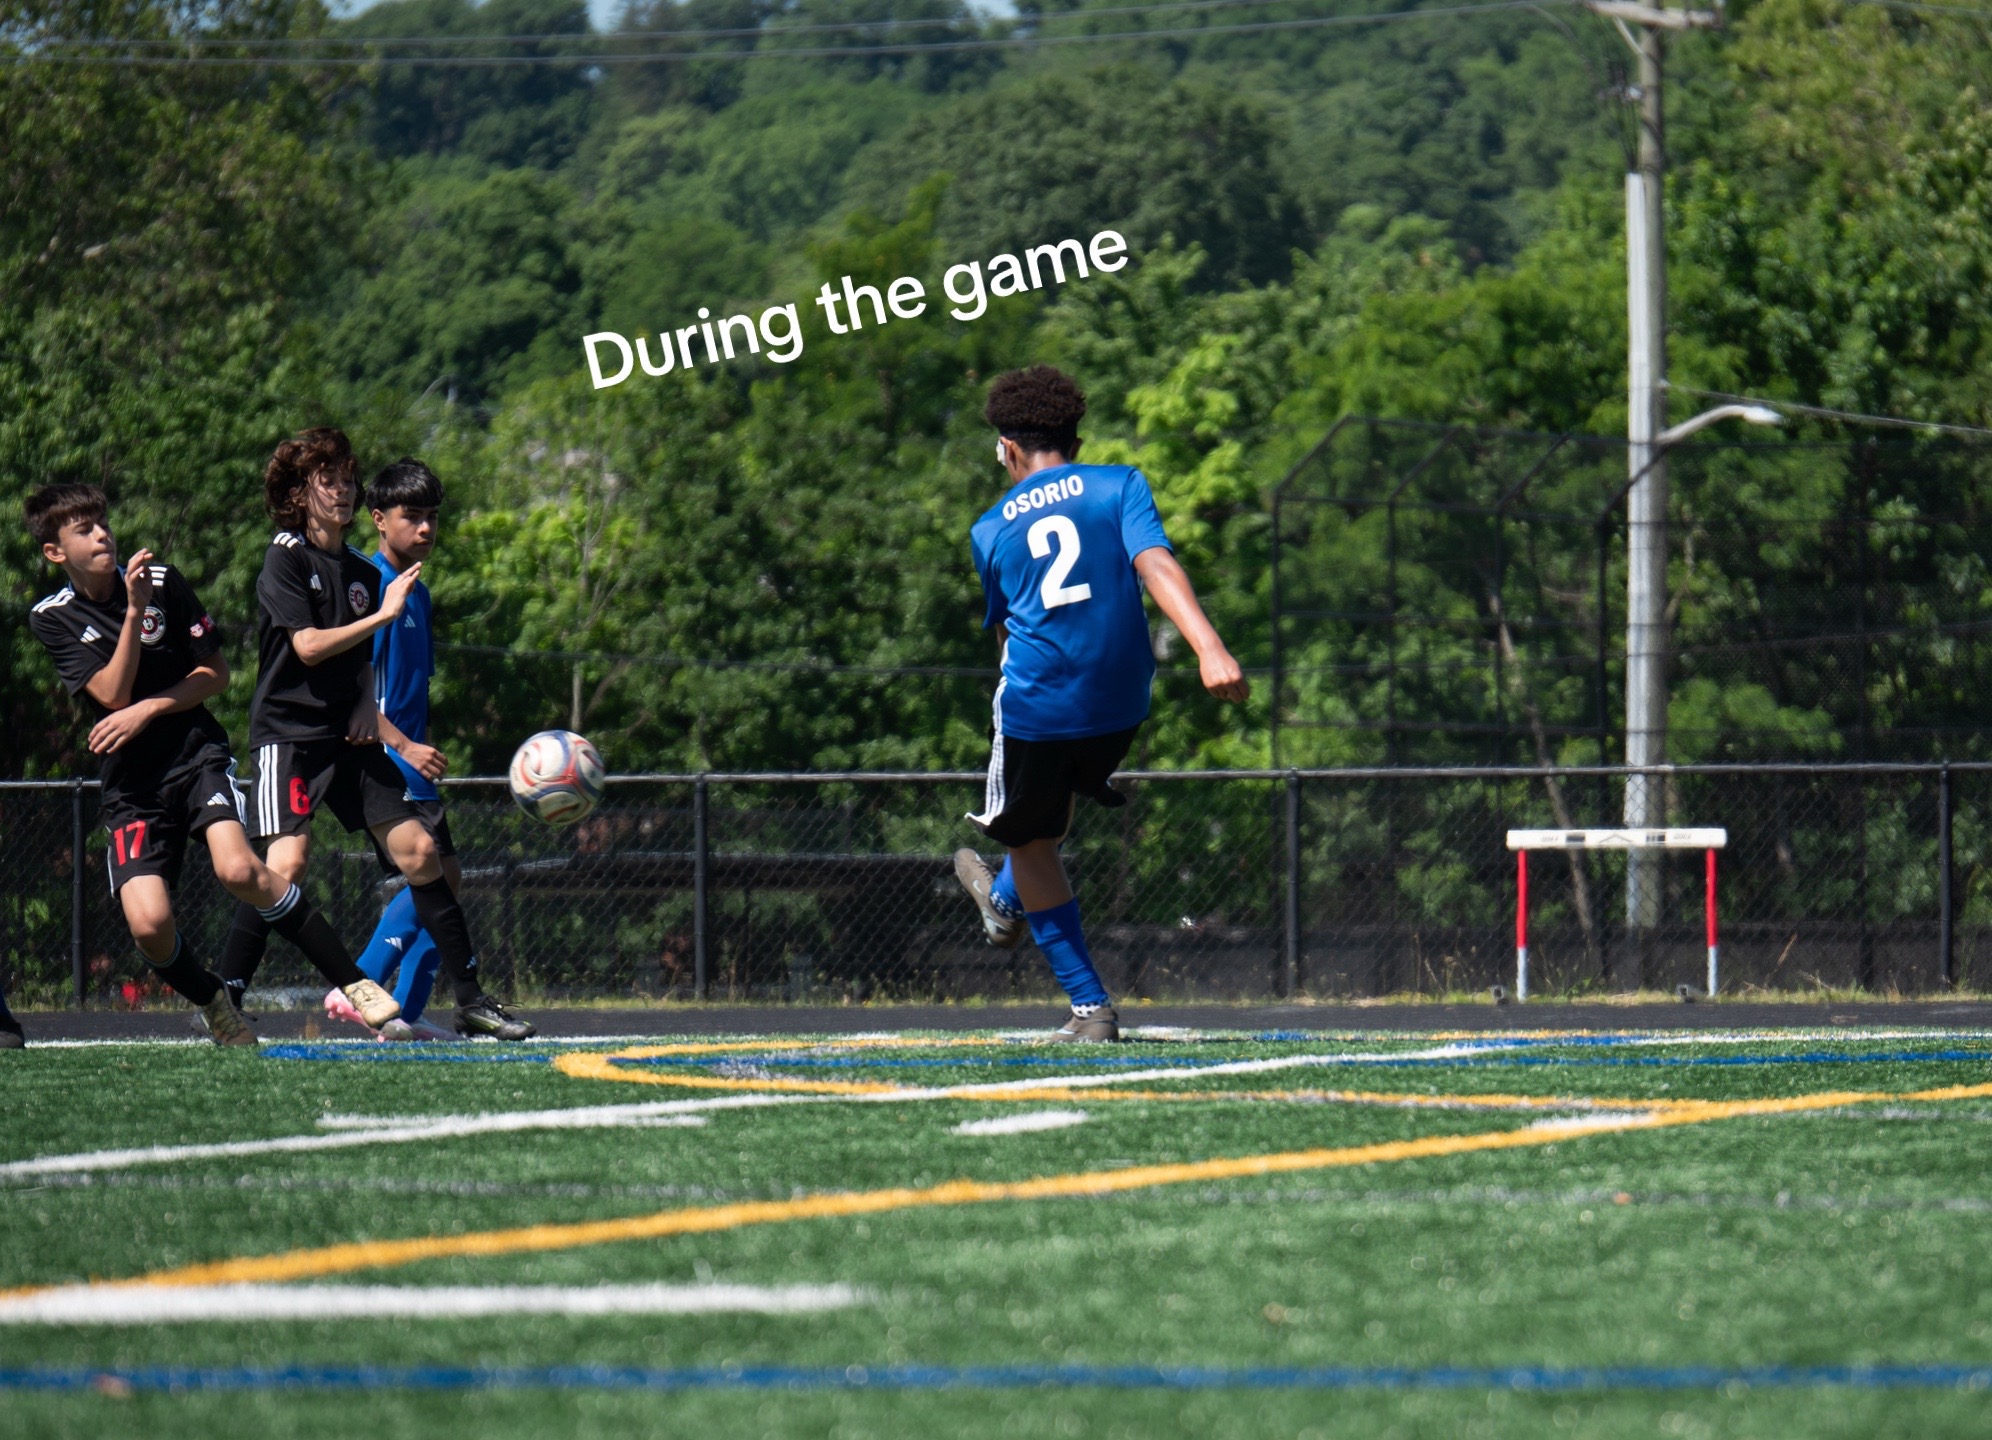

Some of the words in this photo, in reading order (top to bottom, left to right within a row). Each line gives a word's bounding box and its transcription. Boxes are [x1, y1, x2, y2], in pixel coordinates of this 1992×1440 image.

[1003, 475, 1084, 521] OSORIO
[1027, 515, 1092, 610] 2
[289, 776, 310, 815] 6
[114, 820, 146, 866] 17
